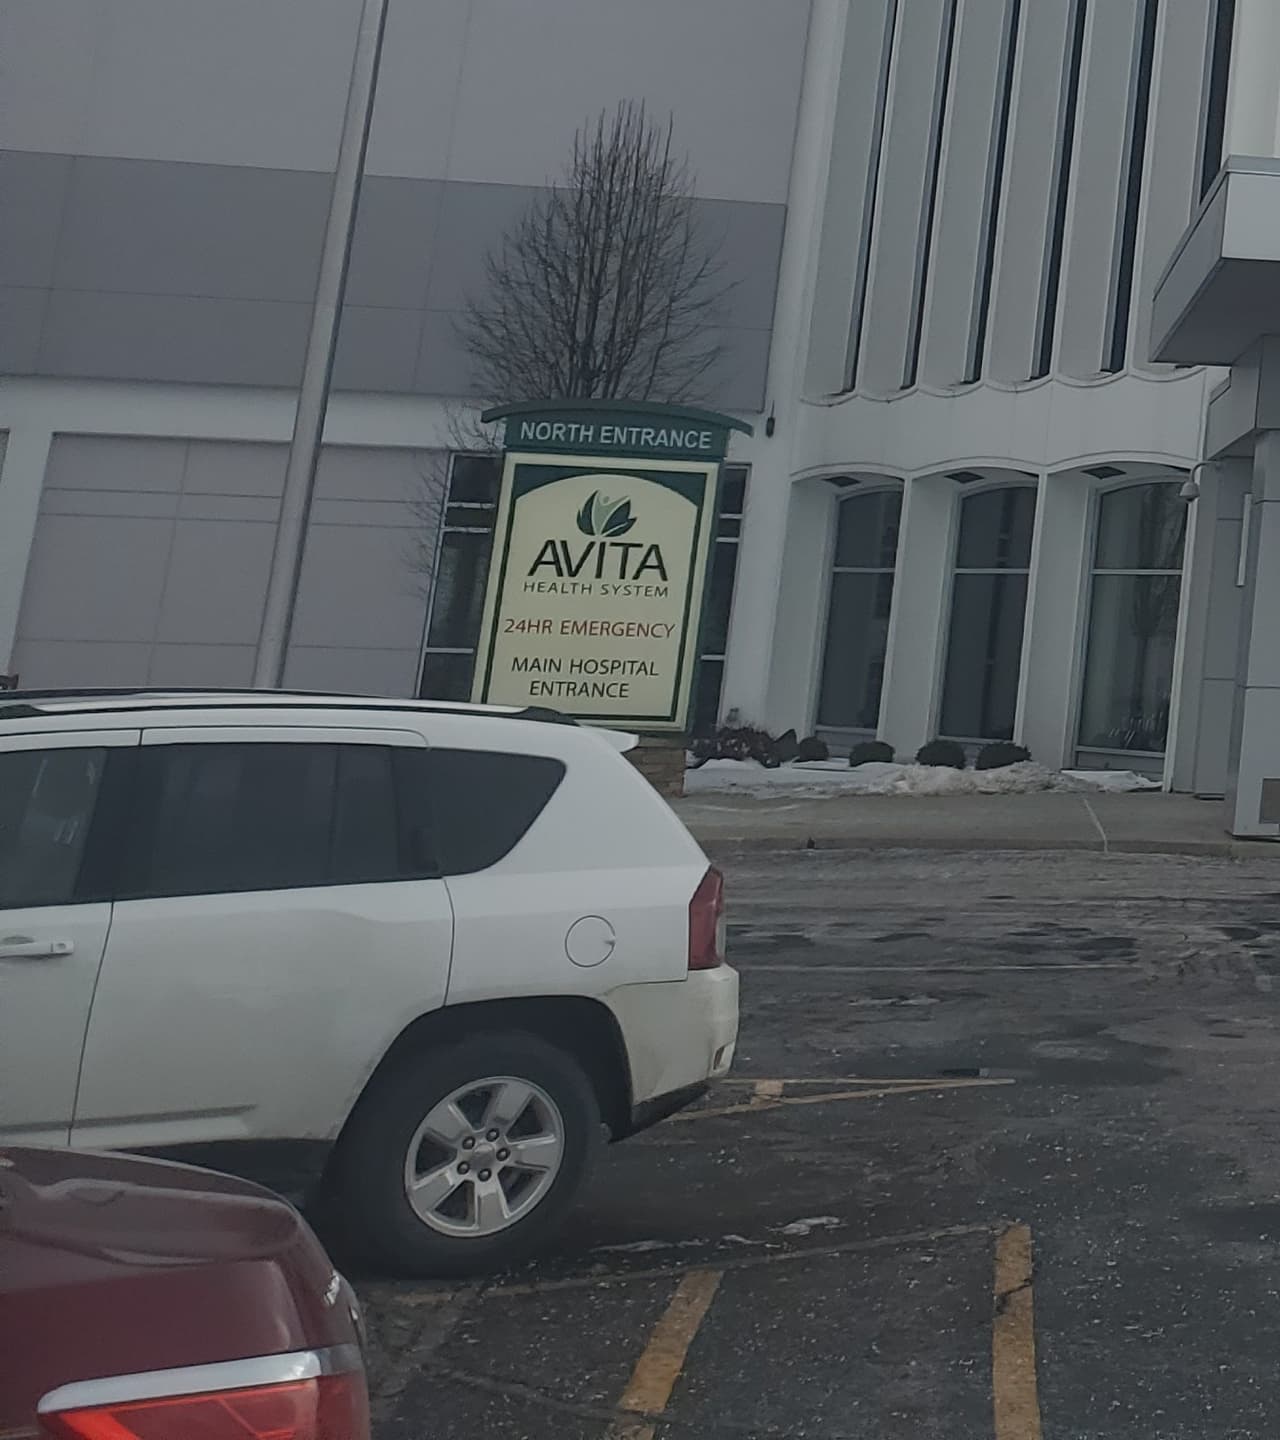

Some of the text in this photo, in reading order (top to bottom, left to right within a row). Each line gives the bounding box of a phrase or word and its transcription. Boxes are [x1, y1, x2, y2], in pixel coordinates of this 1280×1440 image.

[519, 421, 713, 450] NORTH ENTRANCE
[527, 539, 669, 582] AVITA
[523, 581, 670, 598] HEALTH SYSTEM
[503, 618, 676, 639] 24HR EMERGENCY
[511, 656, 660, 677] MAIN HOSPITAL
[529, 680, 630, 698] ENTRANCE
